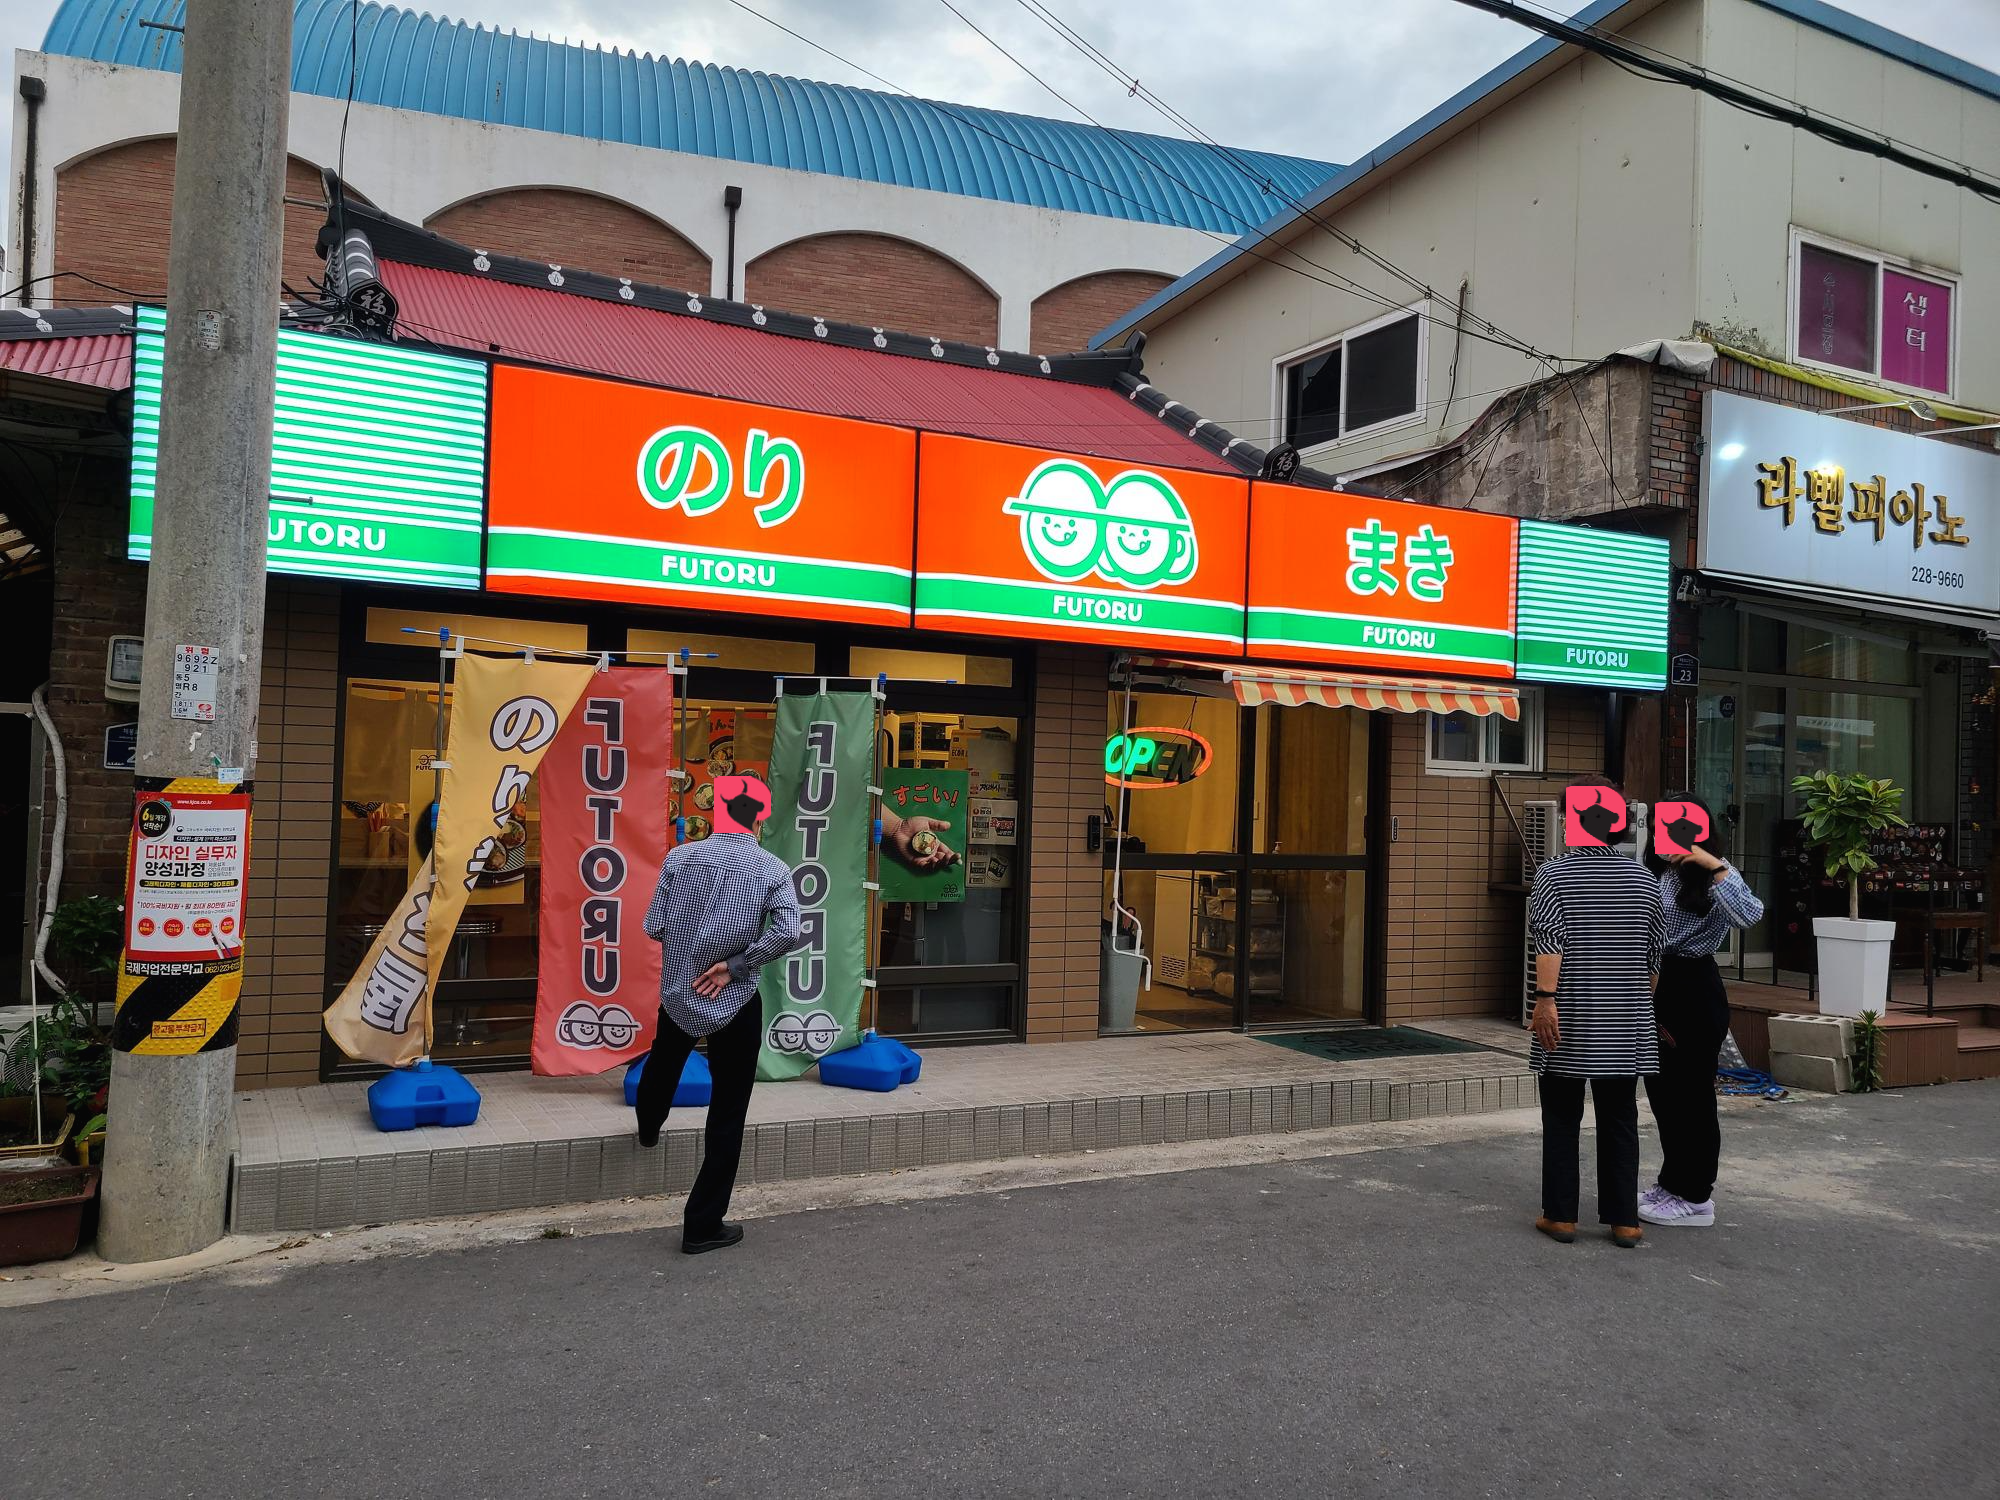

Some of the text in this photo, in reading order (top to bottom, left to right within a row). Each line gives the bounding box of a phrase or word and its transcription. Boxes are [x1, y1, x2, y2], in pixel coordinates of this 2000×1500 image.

[1903, 292, 1928, 351] 샘터
[636, 424, 805, 528] のり
[1756, 456, 1970, 549] 라벨피아노
[267, 517, 387, 551] UTORU
[661, 555, 777, 587] FUTORU
[1346, 518, 1455, 602] まき
[1911, 566, 1965, 589] 228-9660
[1053, 595, 1144, 622] FUTORU
[1362, 626, 1437, 650] FUTORU
[177, 653, 218, 665] 9692Z
[184, 664, 207, 673] 921
[1566, 646, 1630, 669] FUTORU
[1680, 669, 1692, 682] 23
[1105, 735, 1201, 783] OPEN
[891, 783, 959, 807] すごい!
[145, 844, 237, 861] 디자인 실무자
[145, 861, 205, 877] 양성과정
[126, 961, 203, 976] 국제직업전문학교
